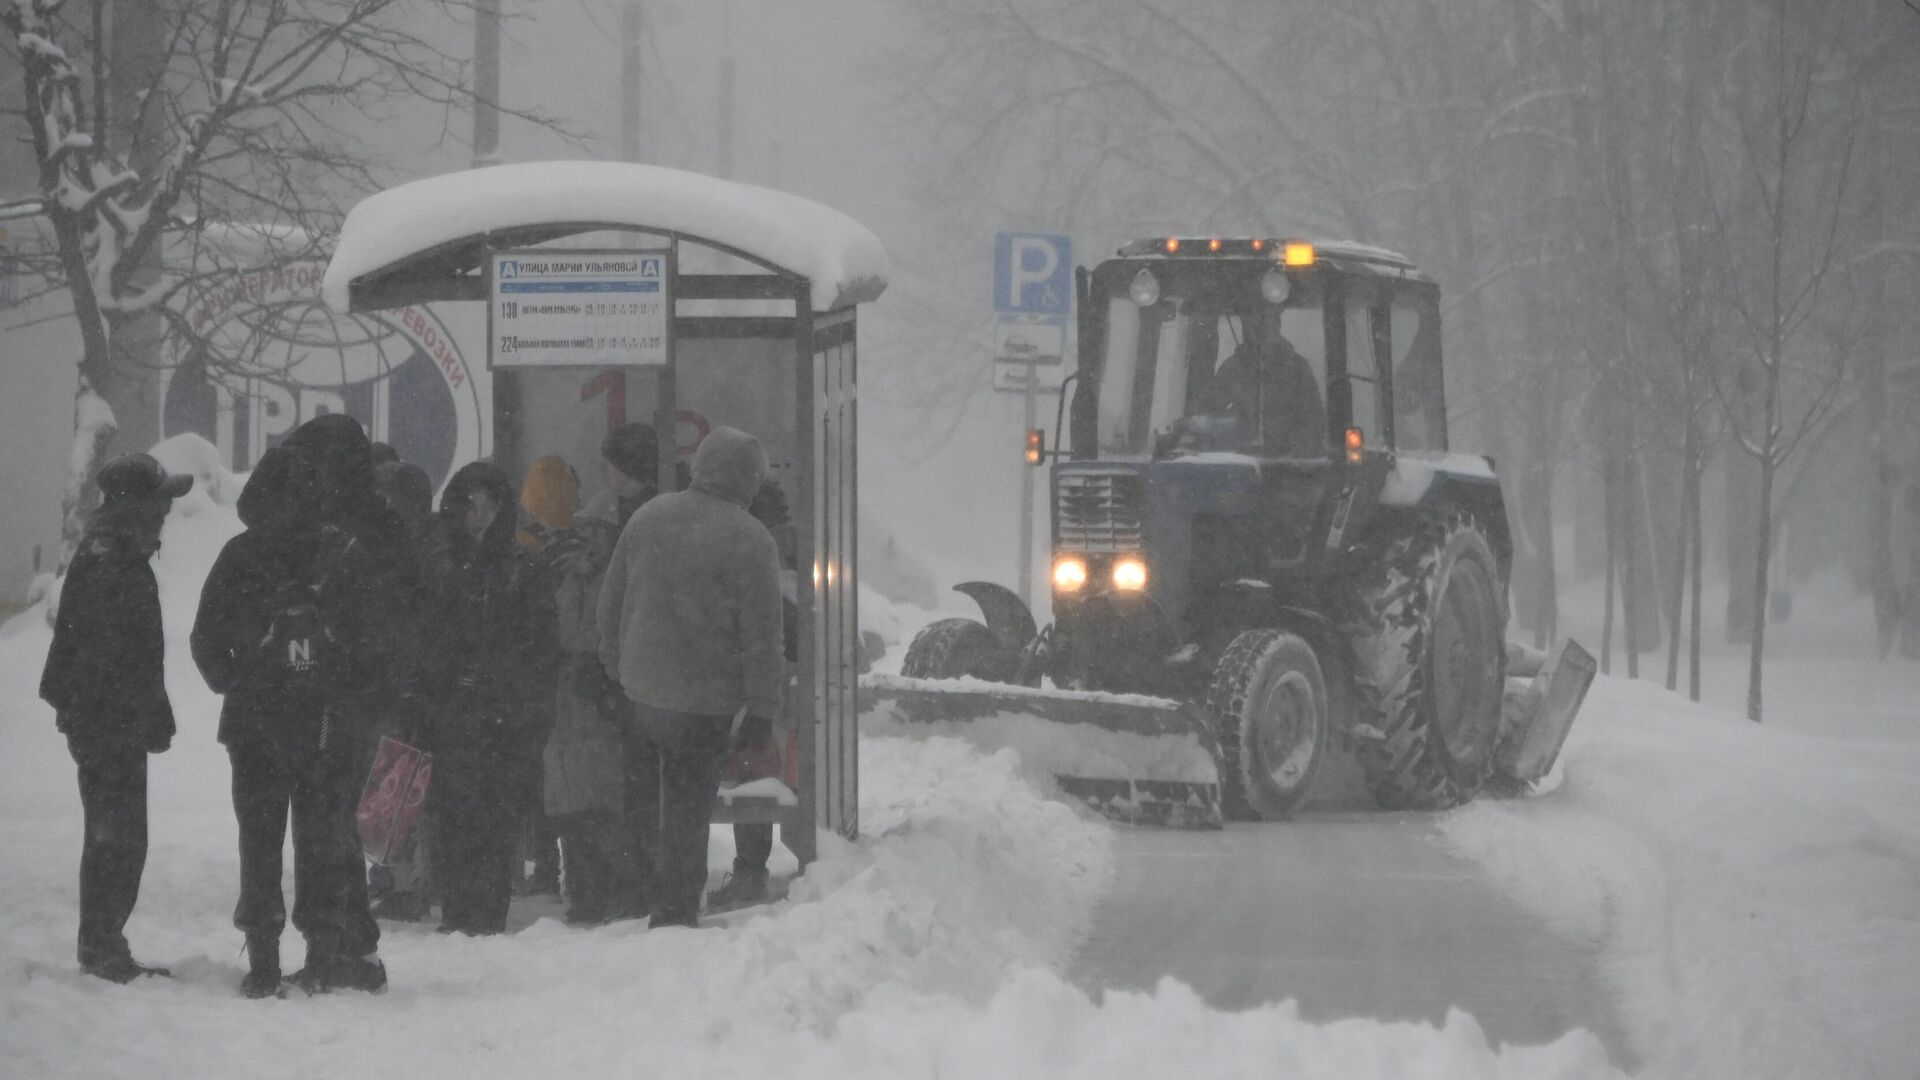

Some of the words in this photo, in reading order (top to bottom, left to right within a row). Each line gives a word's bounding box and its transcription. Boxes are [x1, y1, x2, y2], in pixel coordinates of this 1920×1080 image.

[502, 262, 516, 278] А
[519, 262, 549, 275] УЛИЦА
[551, 262, 583, 274] МАРИИ
[584, 260, 638, 274] УЛЬЯНОВОЙ
[643, 260, 657, 277] А
[1010, 237, 1059, 307] P
[502, 302, 518, 319] 138
[501, 335, 518, 353] 224
[288, 638, 310, 662] N
